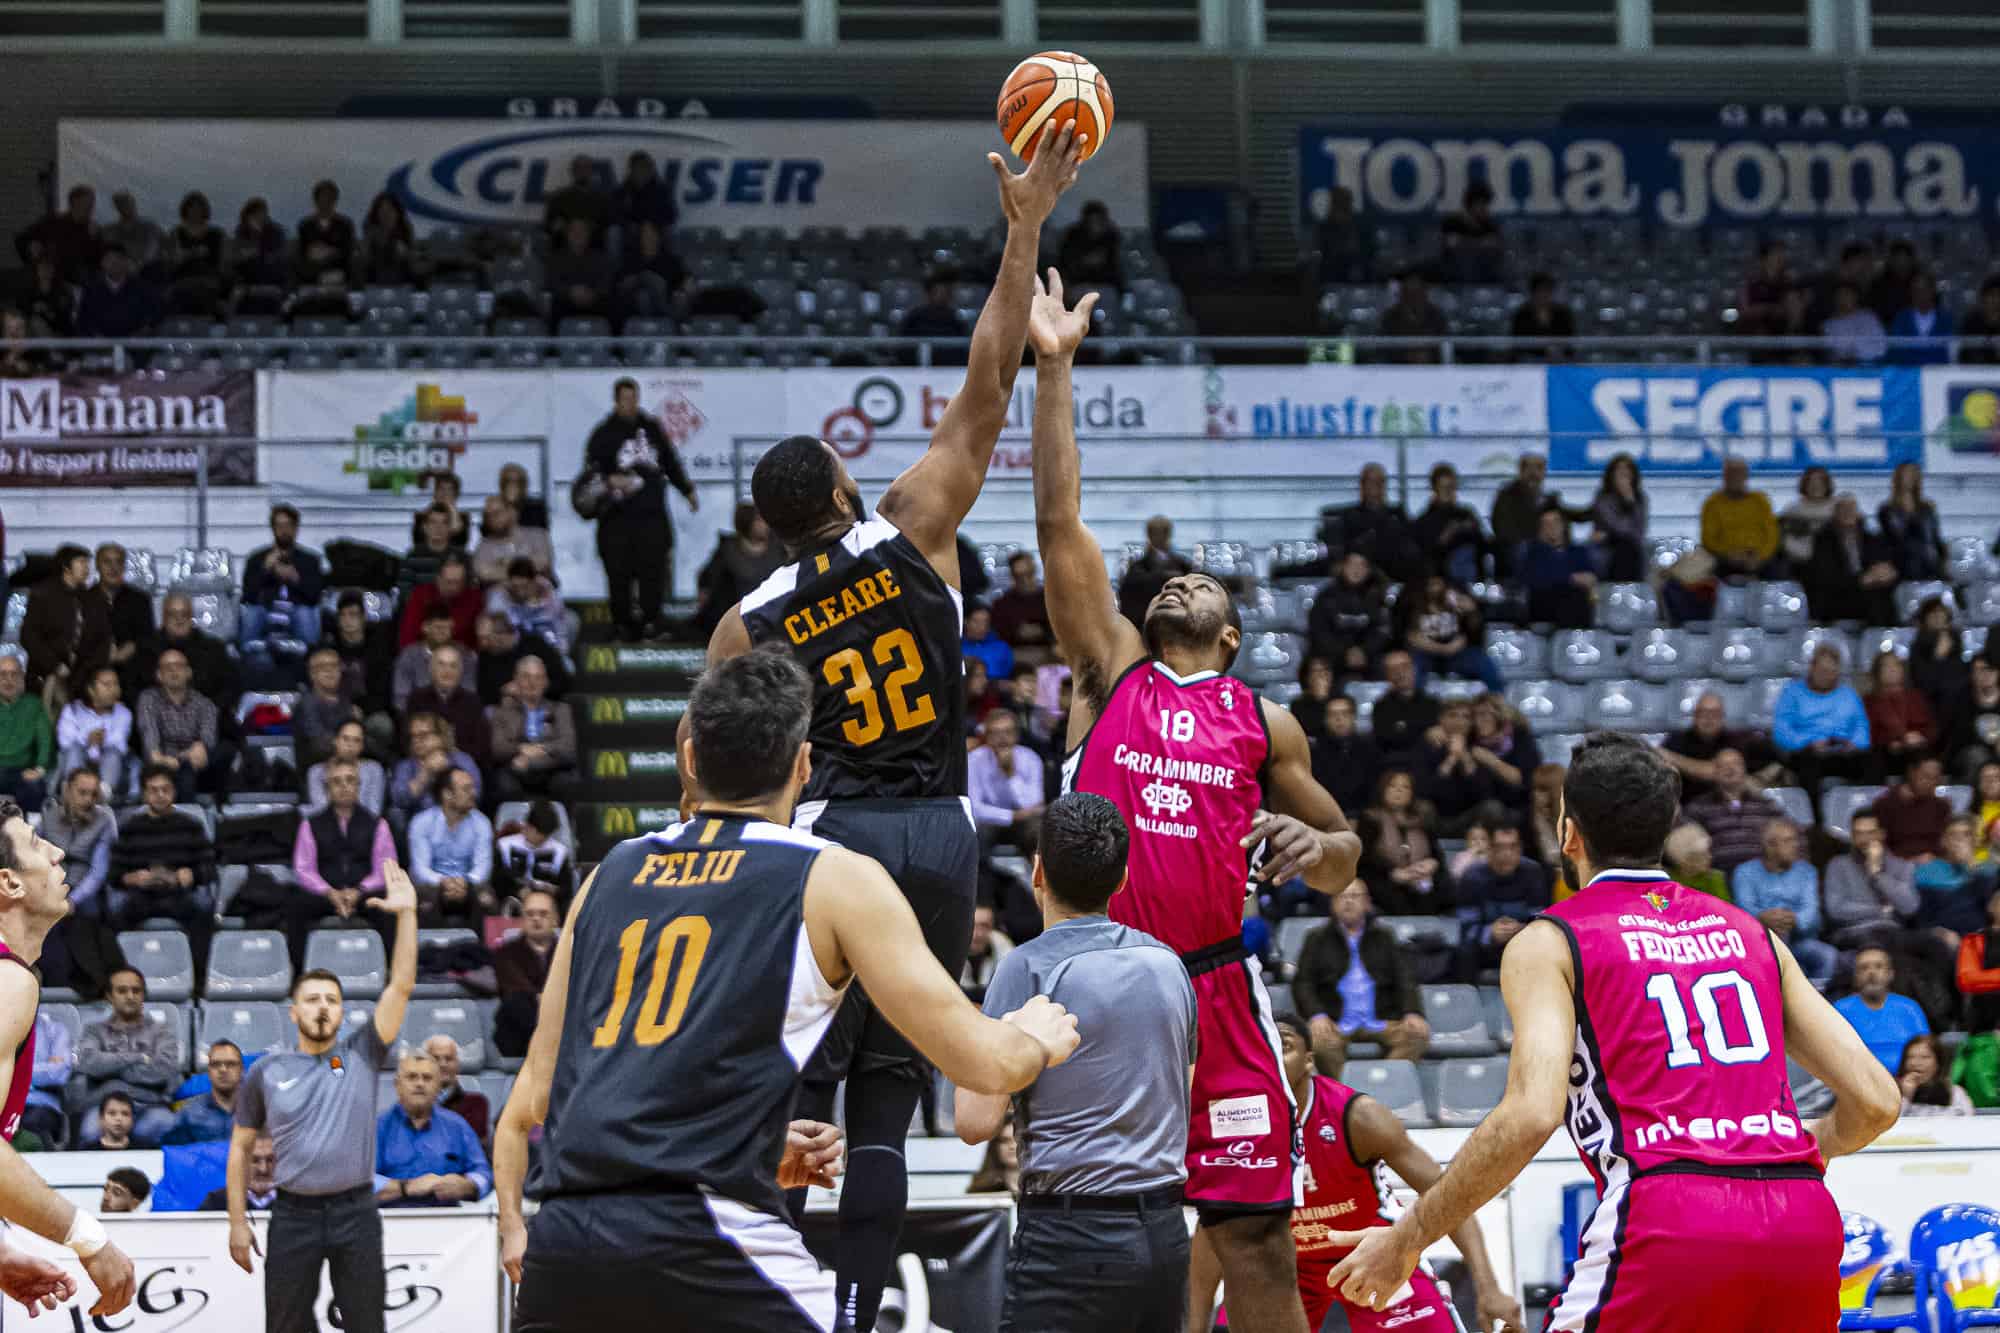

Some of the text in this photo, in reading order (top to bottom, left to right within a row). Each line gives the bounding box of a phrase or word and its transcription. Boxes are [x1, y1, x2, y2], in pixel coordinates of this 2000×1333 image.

[506, 98, 711, 117] GRADA
[1720, 104, 1909, 126] GRADA
[1656, 139, 1980, 229] Joma
[6, 384, 227, 432] Mañana
[1587, 377, 1888, 463] SEGRE
[783, 568, 902, 645] CLEARE
[822, 627, 936, 747] 32
[1159, 709, 1196, 743] 18
[632, 850, 747, 887] FELIU
[1621, 929, 1747, 965] FEDERICO
[592, 915, 712, 1049] 10
[1645, 969, 1772, 1071] 10
[1200, 1155, 1278, 1170] LEXUS
[1376, 1305, 1436, 1329] LEXUS
